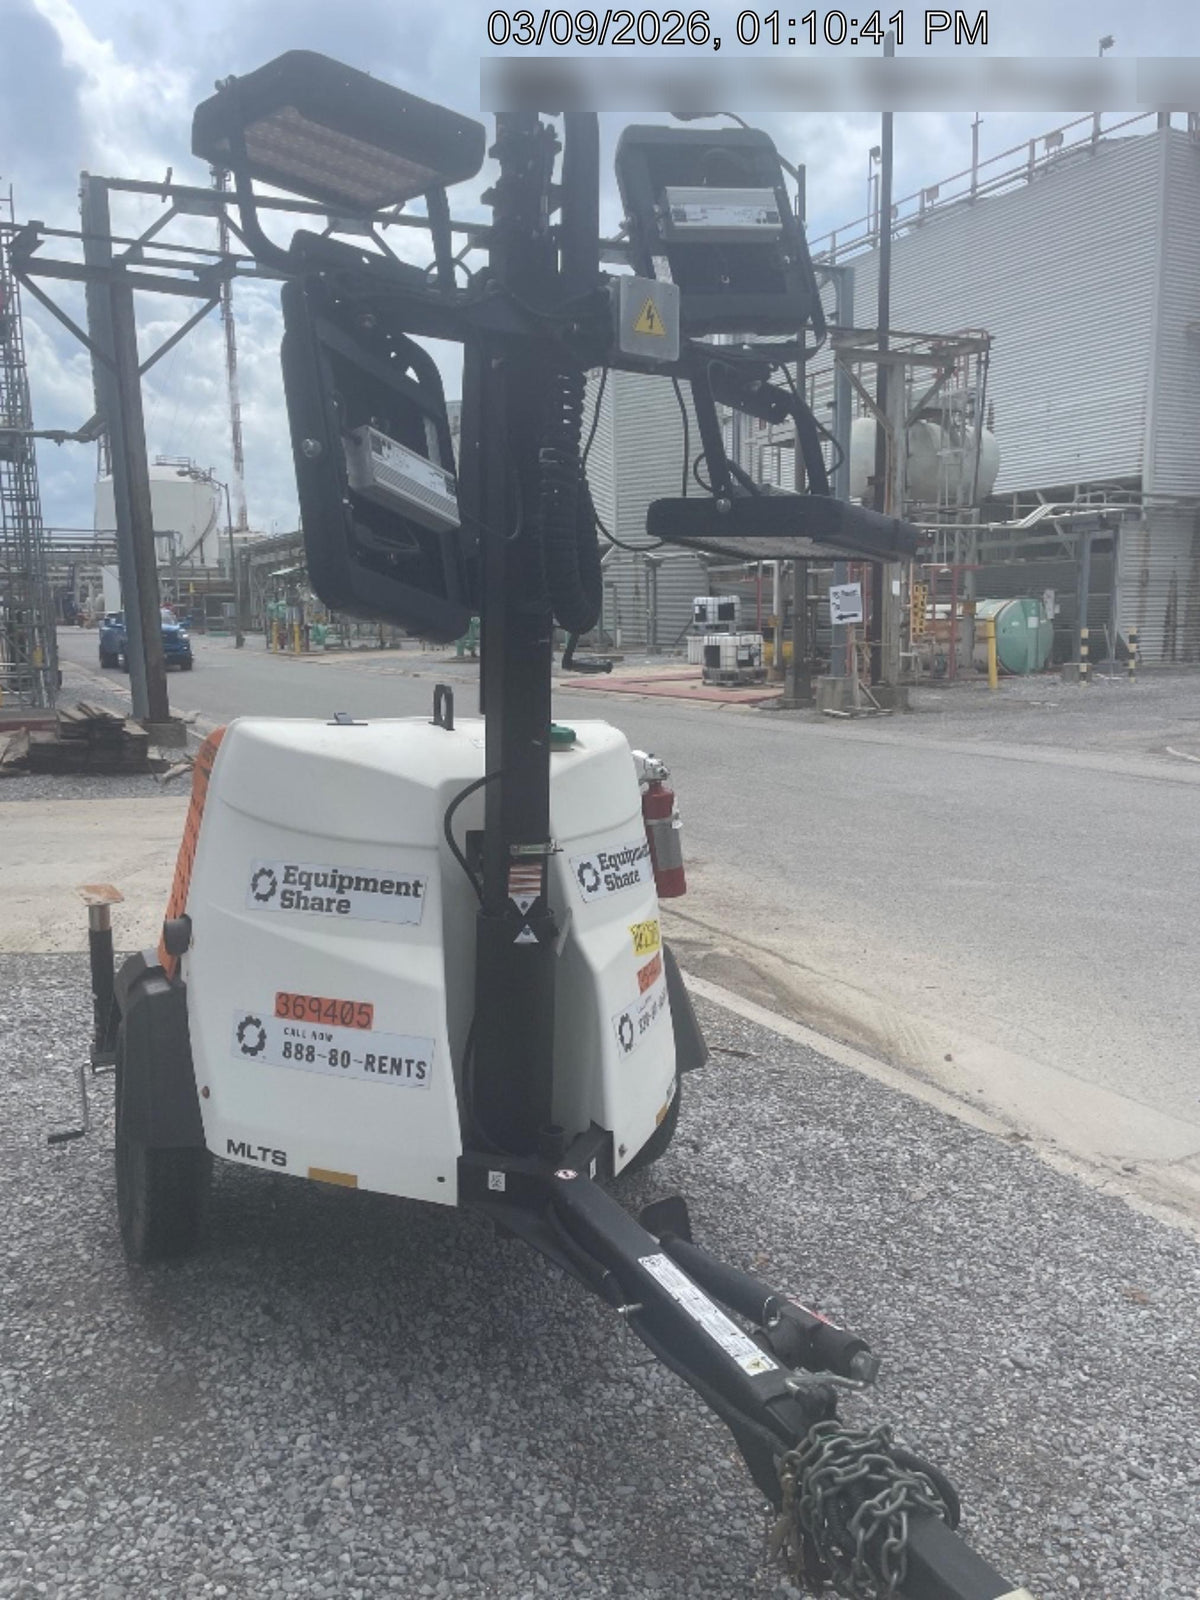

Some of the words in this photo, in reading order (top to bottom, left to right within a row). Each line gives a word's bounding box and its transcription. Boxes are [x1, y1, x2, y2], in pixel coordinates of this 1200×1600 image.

[282, 865, 424, 898] Equipment
[604, 870, 641, 891] Share
[280, 890, 352, 915] Share
[276, 993, 373, 1029] 369405
[284, 1027, 307, 1040] CALL
[311, 1030, 333, 1042] NOW
[282, 1041, 427, 1080] 888-80-RENTS
[226, 1139, 288, 1167] MLTS
